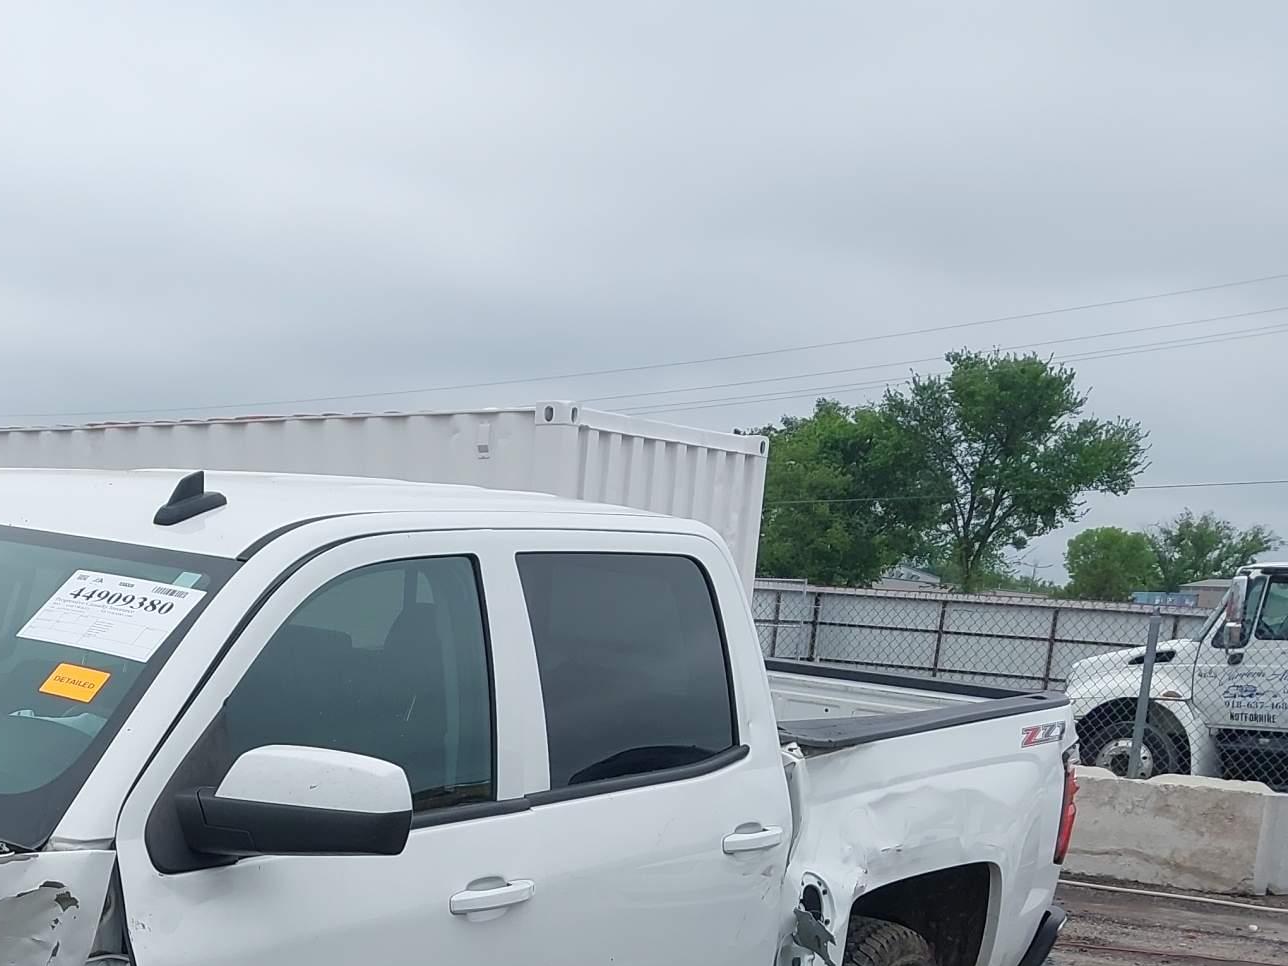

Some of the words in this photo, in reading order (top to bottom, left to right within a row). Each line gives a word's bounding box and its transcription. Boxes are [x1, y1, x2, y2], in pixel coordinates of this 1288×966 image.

[70, 586, 175, 615] 44909380
[53, 675, 96, 690] DETAILED
[1021, 721, 1066, 748] Z71
